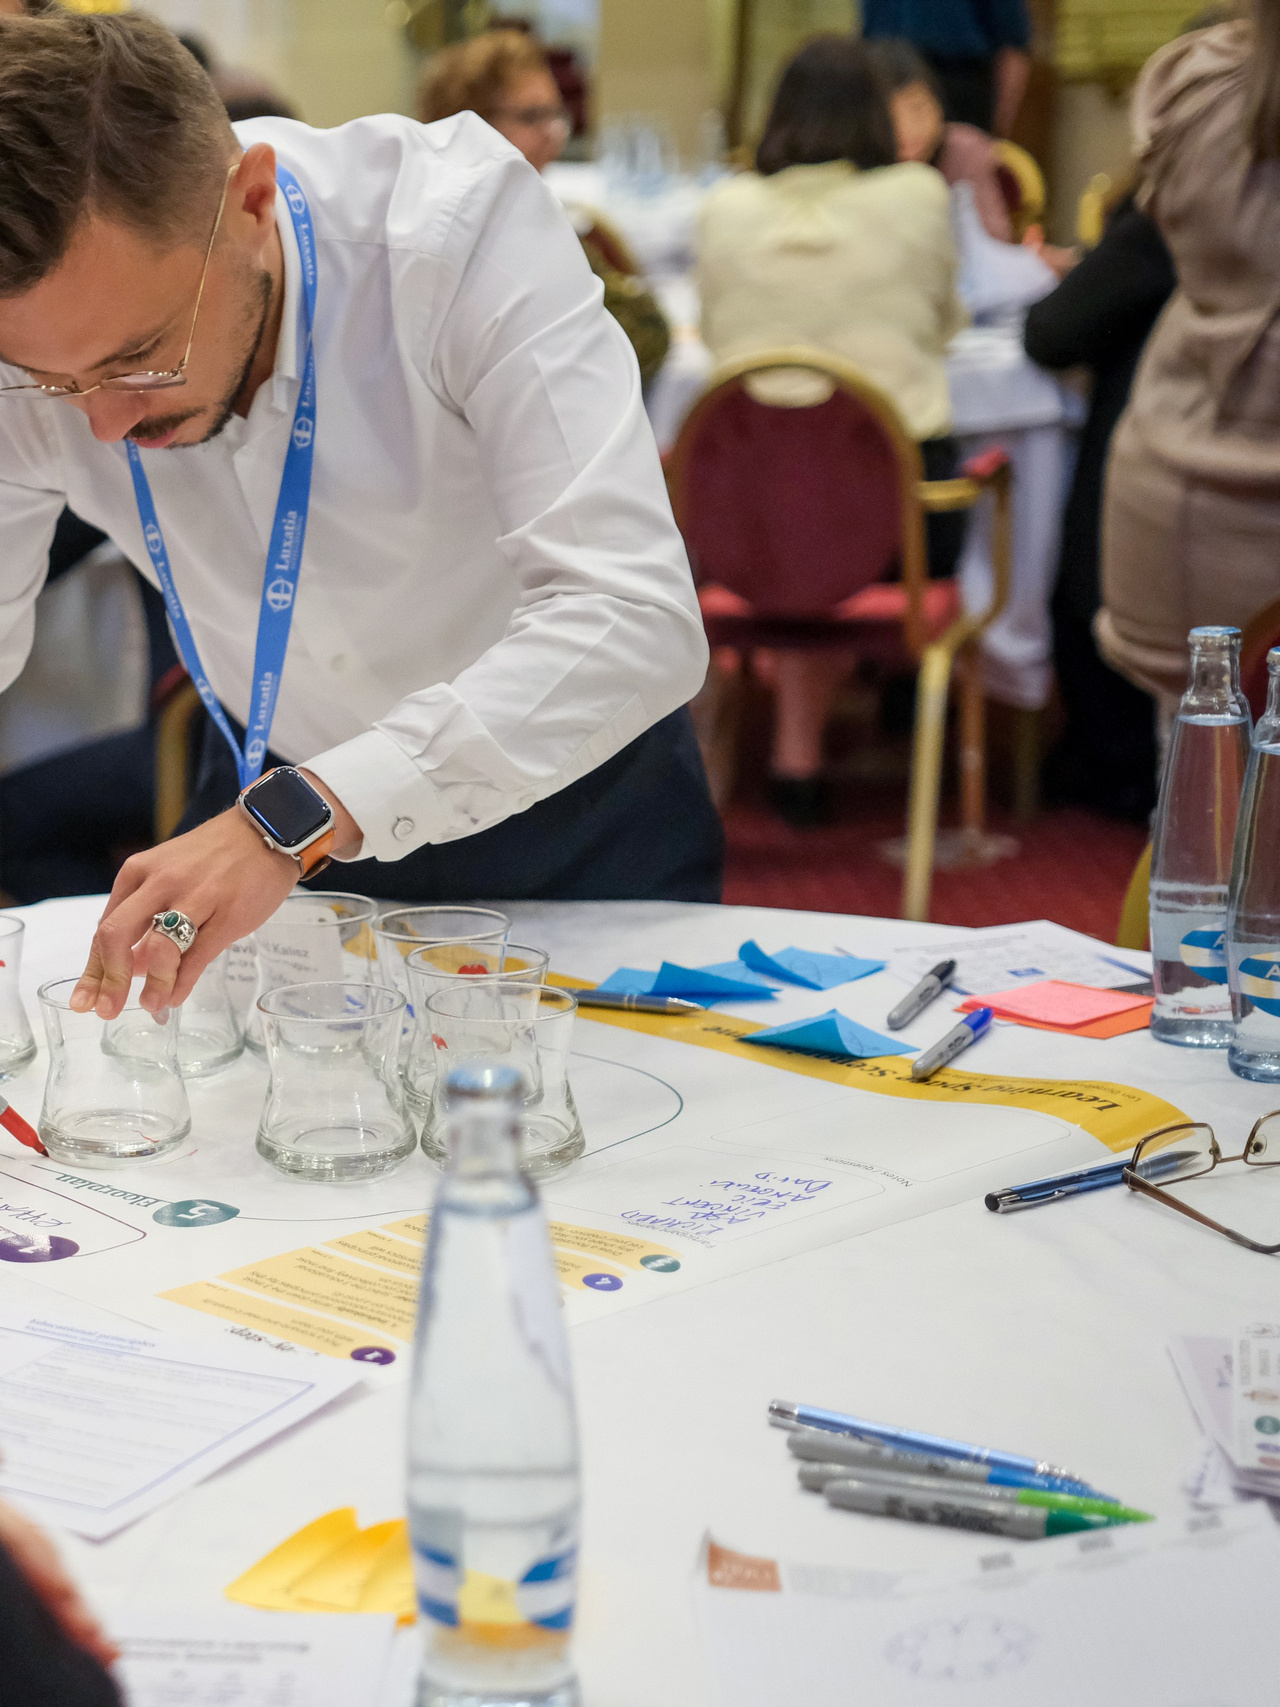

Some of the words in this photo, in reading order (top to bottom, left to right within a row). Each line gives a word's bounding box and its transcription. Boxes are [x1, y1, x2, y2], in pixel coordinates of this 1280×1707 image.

[279, 510, 298, 573] Luxatia
[255, 670, 273, 732] Luxatia
[982, 1085, 1122, 1112] Learning
[54, 1173, 160, 1208] Floorplan
[881, 1169, 913, 1188] Notes
[176, 1205, 220, 1220] 5
[620, 1209, 724, 1237] RICHARD
[595, 1277, 612, 1285] 4
